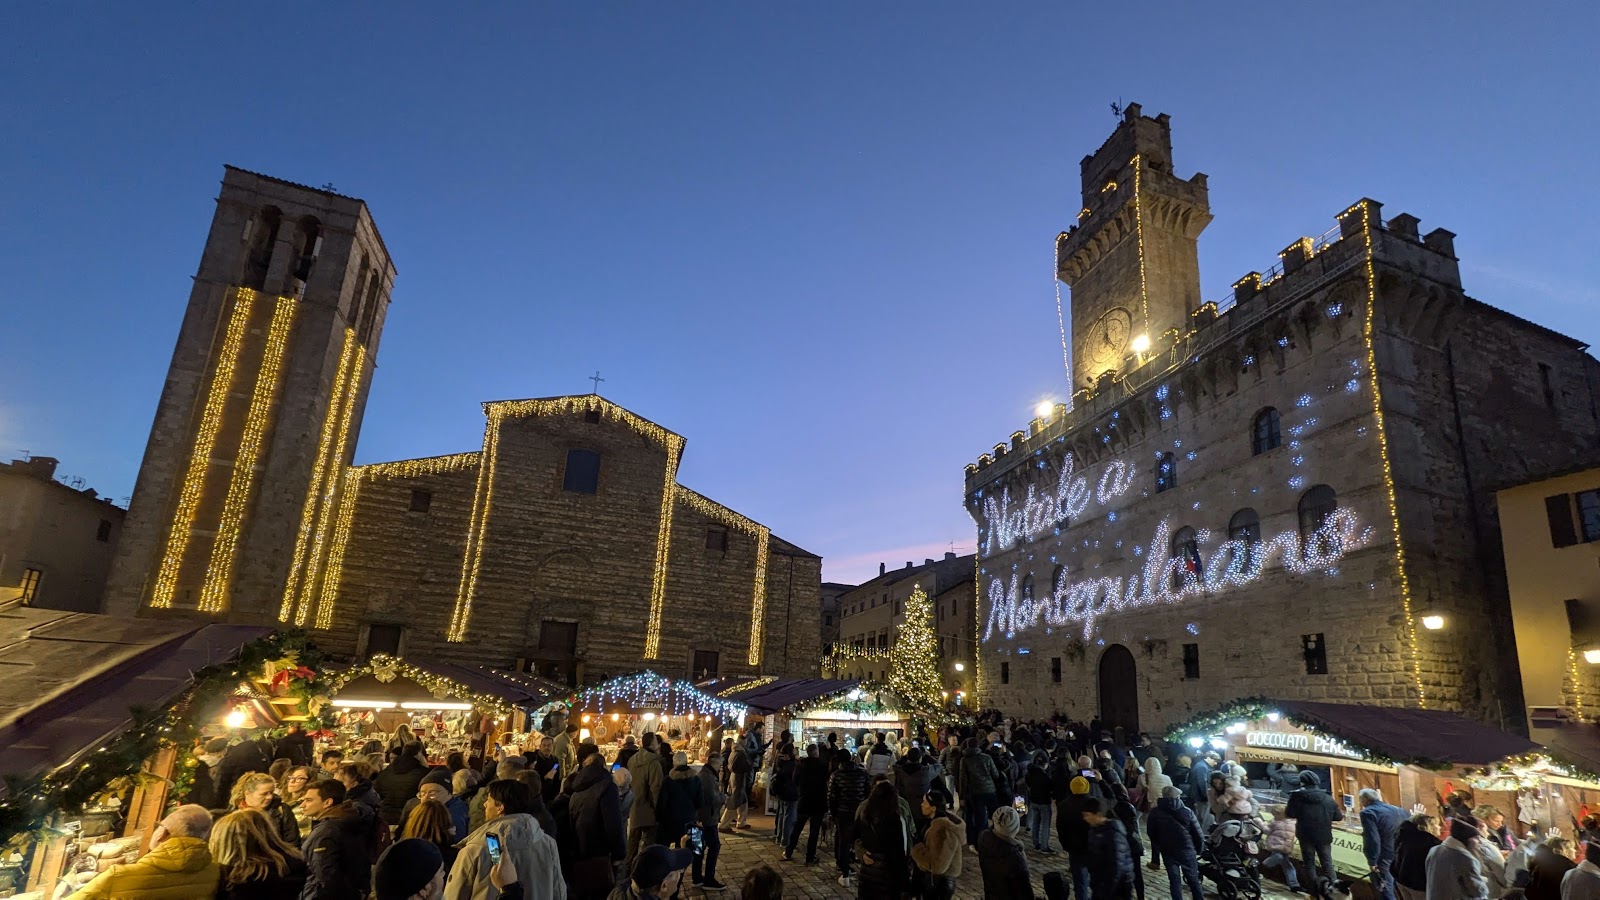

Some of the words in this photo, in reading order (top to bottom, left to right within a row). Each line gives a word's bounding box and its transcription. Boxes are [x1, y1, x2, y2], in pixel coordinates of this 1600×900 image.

[982, 452, 1091, 557] Natale
[1097, 459, 1136, 505] a
[982, 509, 1375, 643] Montepulciano
[1246, 732, 1309, 750] CIOCCOLATO
